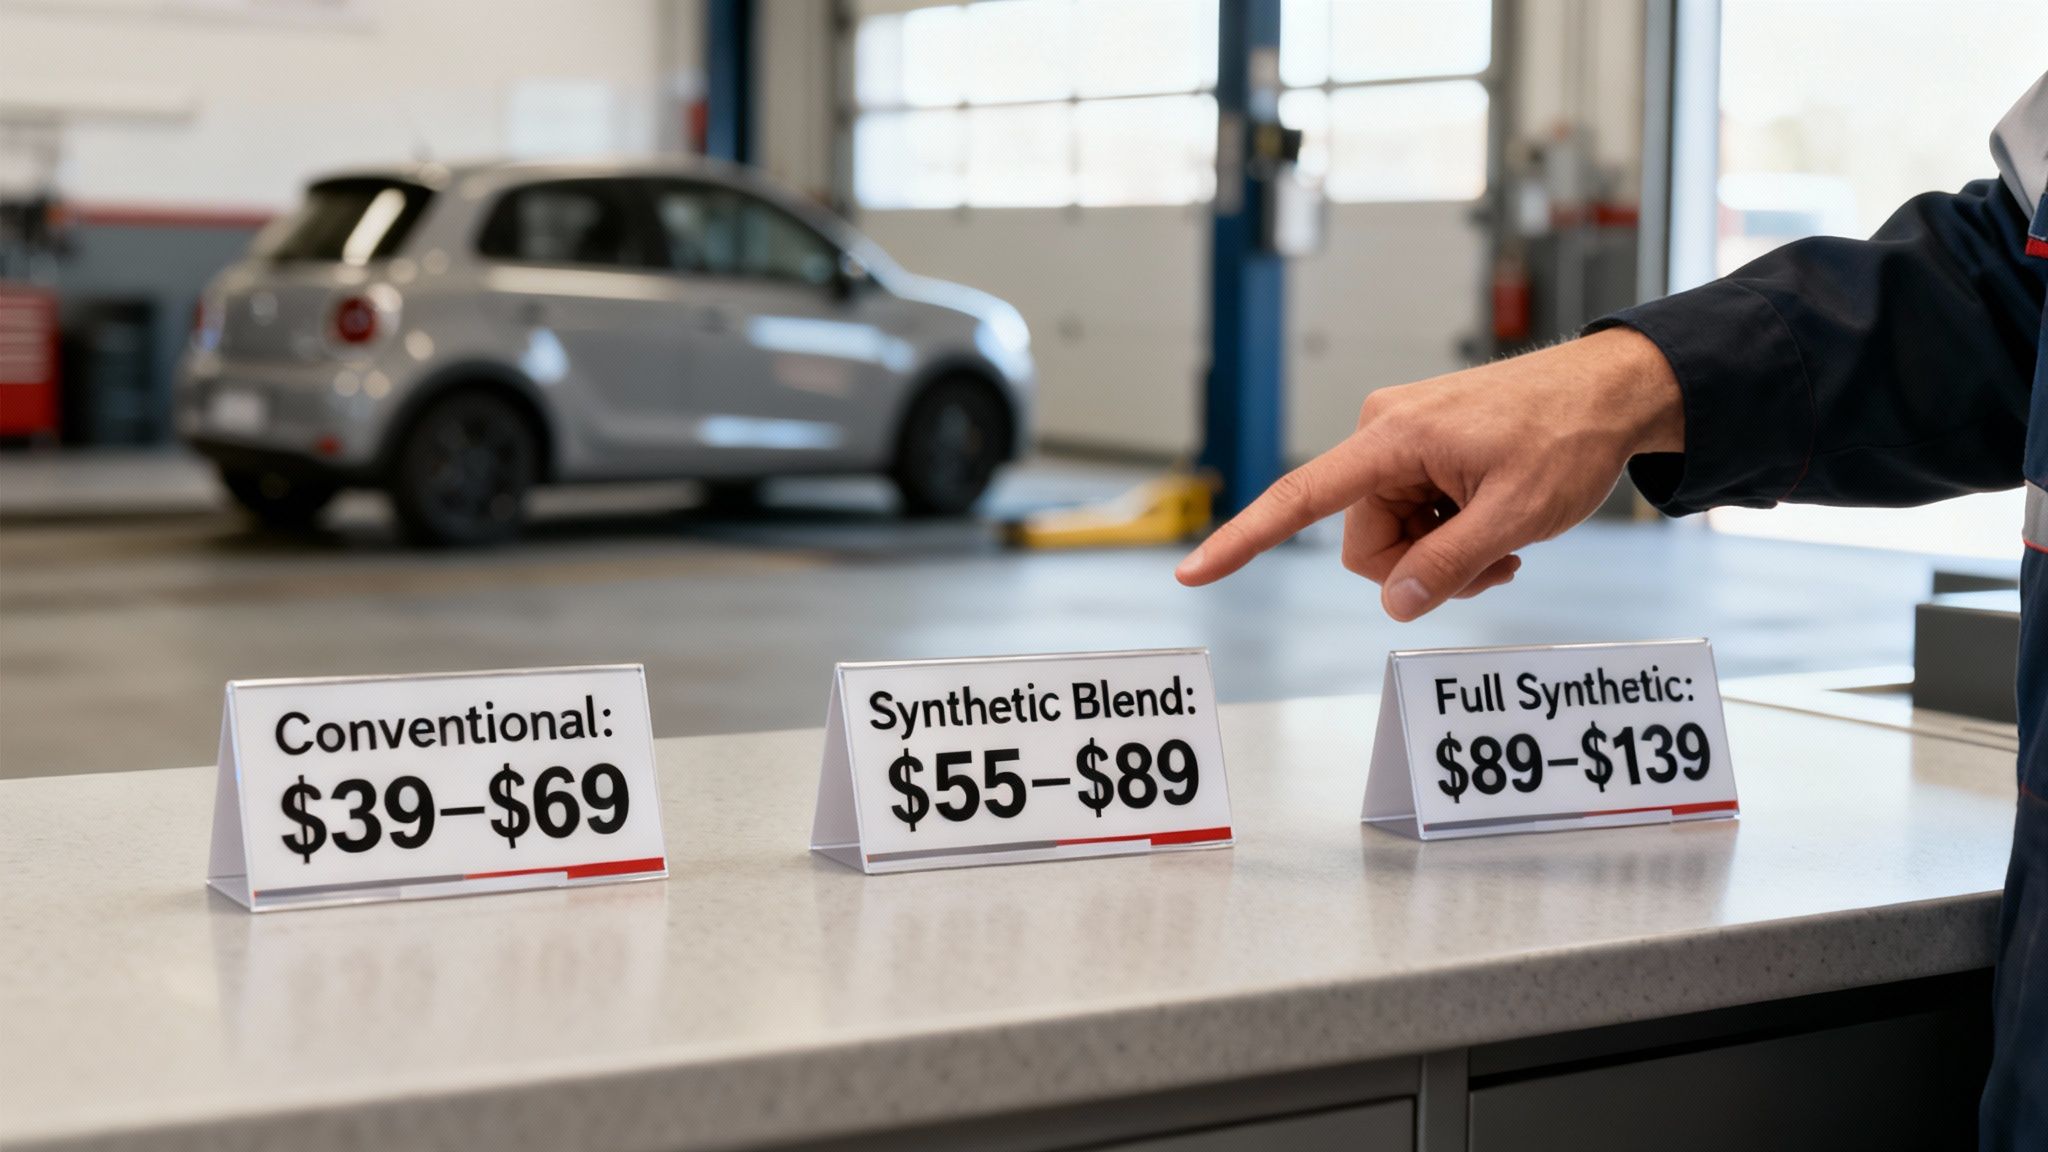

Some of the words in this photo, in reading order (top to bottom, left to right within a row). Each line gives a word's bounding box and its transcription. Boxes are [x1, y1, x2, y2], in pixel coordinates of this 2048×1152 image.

[275, 694, 613, 756] Conventional:
[869, 682, 1061, 741] Synthetic
[1071, 675, 1197, 720] Blend:
[1434, 672, 1506, 715] Full
[1516, 665, 1695, 720] Synthetic:
[888, 737, 1200, 832] $55–$89
[1435, 721, 1711, 804] $89–$139
[281, 763, 630, 864] $39–$69
